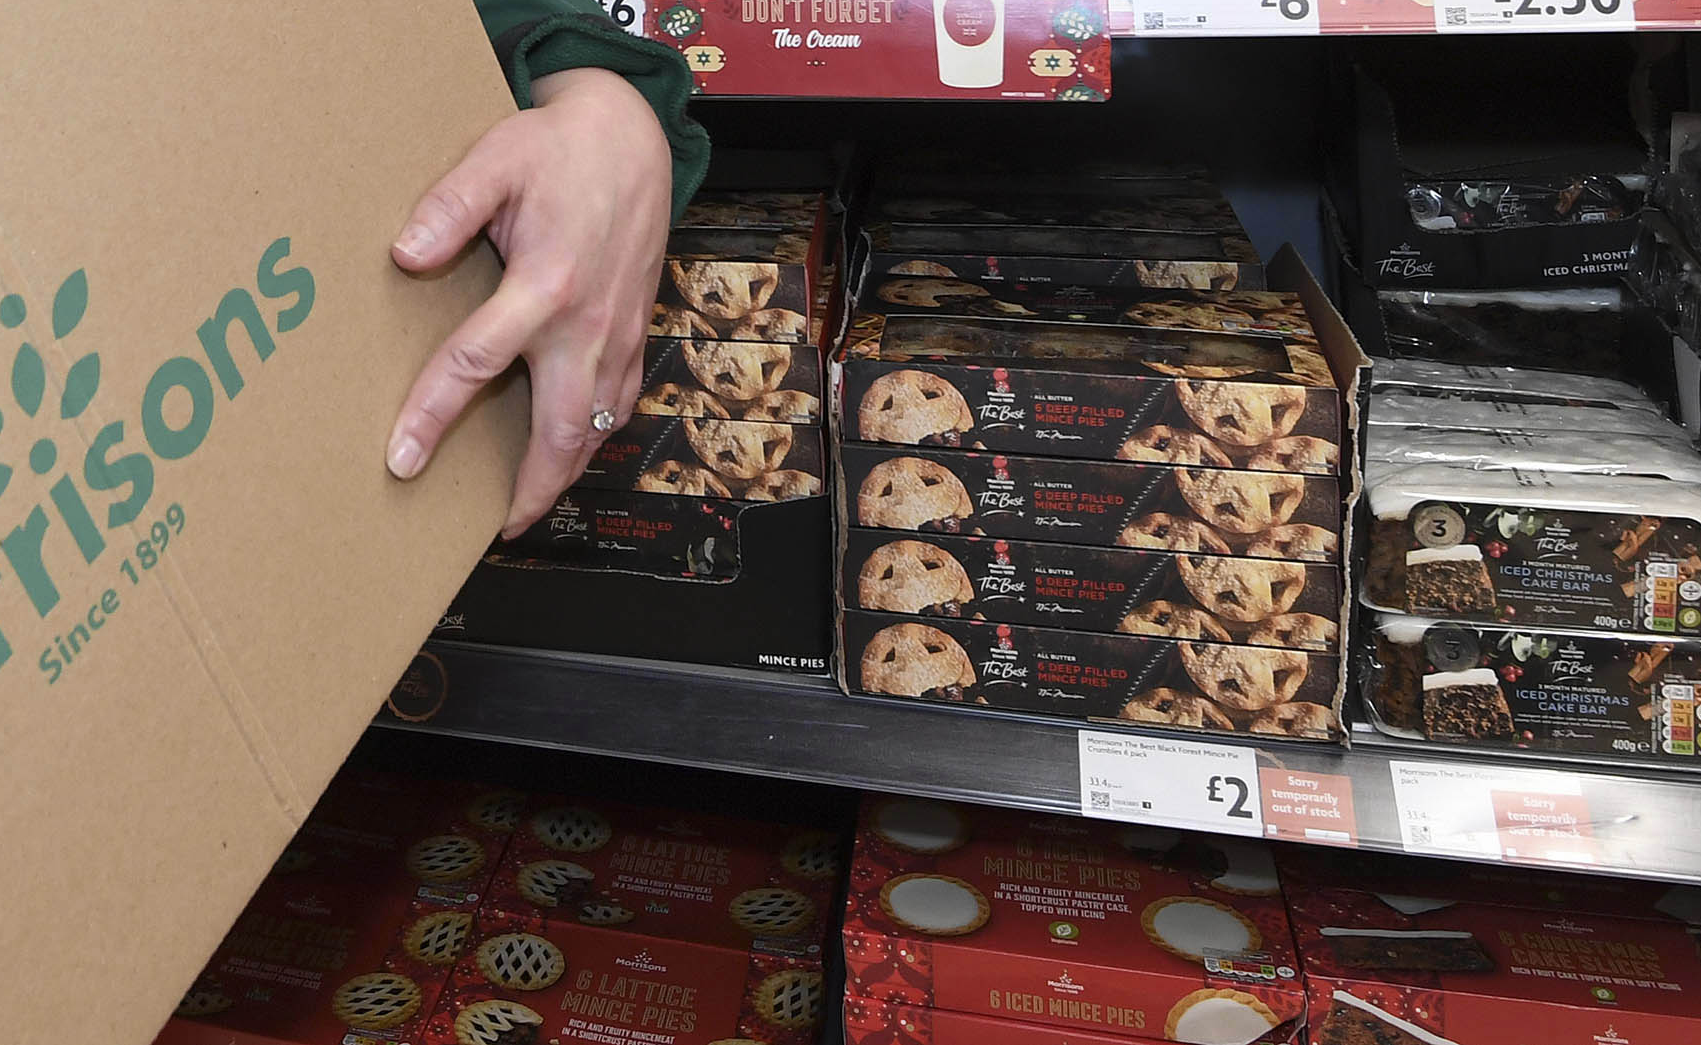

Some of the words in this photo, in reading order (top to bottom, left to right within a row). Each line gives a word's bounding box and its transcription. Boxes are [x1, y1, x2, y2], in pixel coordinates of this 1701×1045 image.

[772, 28, 801, 49] The
[805, 29, 862, 48] Cream
[1543, 267, 1569, 277] ICED
[1033, 394, 1046, 402] ALL
[1047, 395, 1074, 403] BUTTER
[1033, 403, 1043, 413] 6
[1045, 404, 1079, 416] DEEP
[1081, 406, 1125, 419] FILLED
[1035, 413, 1075, 426] MINCE
[1077, 416, 1107, 427] PIES
[1033, 490, 1042, 500] 6
[1045, 491, 1078, 502] DEEP
[1080, 493, 1124, 505] FILLED
[1034, 500, 1074, 513] MINCE
[1077, 503, 1106, 514] PIES
[1500, 565, 1531, 577] ICED
[1535, 568, 1613, 584] CHRISTMAS
[38, 587, 120, 685] Since
[118, 501, 186, 586] 1899
[1521, 577, 1558, 590] CAKE
[1561, 580, 1591, 592] BAR
[1538, 700, 1574, 713] CAKE
[1578, 703, 1608, 715] BAR
[1087, 737, 1123, 748] Morrisons
[1124, 740, 1138, 749] The
[1139, 742, 1156, 751] Best
[1157, 743, 1176, 753] Black
[1178, 745, 1201, 756] Forest
[1203, 749, 1226, 758] Mince
[1227, 751, 1239, 759] Pie
[1087, 745, 1122, 757] Crumbles
[1123, 748, 1129, 756] 6
[1130, 749, 1148, 760] pack
[1287, 775, 1318, 790] Sorry
[1206, 775, 1253, 819] £2
[1271, 788, 1339, 807] temporarily
[1271, 803, 1293, 814] out
[1295, 802, 1307, 815] of
[1310, 805, 1341, 819] stock
[983, 856, 1069, 885] MINCE
[1079, 866, 1141, 891] PIES
[993, 891, 1003, 899] IN
[1005, 892, 1012, 900] A
[1014, 893, 1069, 907] SHORTCRUST
[1071, 899, 1105, 911] PASTRY
[1000, 882, 1021, 893] RICH
[1022, 884, 1041, 895] AND
[1043, 887, 1072, 899] FRUITY
[1074, 890, 1125, 903] MINCEMEAT
[1020, 903, 1054, 915] TOPPED
[1056, 907, 1079, 918] WITH
[1081, 909, 1106, 920] ICING
[575, 969, 593, 990] 6
[597, 973, 697, 1009] LATTICE
[560, 990, 637, 1025] MINCE
[641, 1006, 697, 1033] PIES
[989, 989, 1001, 1008] 6
[1005, 991, 1044, 1015] ICED
[1049, 998, 1102, 1023] MINCE
[1106, 1006, 1146, 1029] PIES
[568, 1018, 586, 1029] RICH
[588, 1022, 603, 1032] AND
[604, 1025, 631, 1038] FRUITY
[631, 1029, 675, 1045] MINCEMEAT
